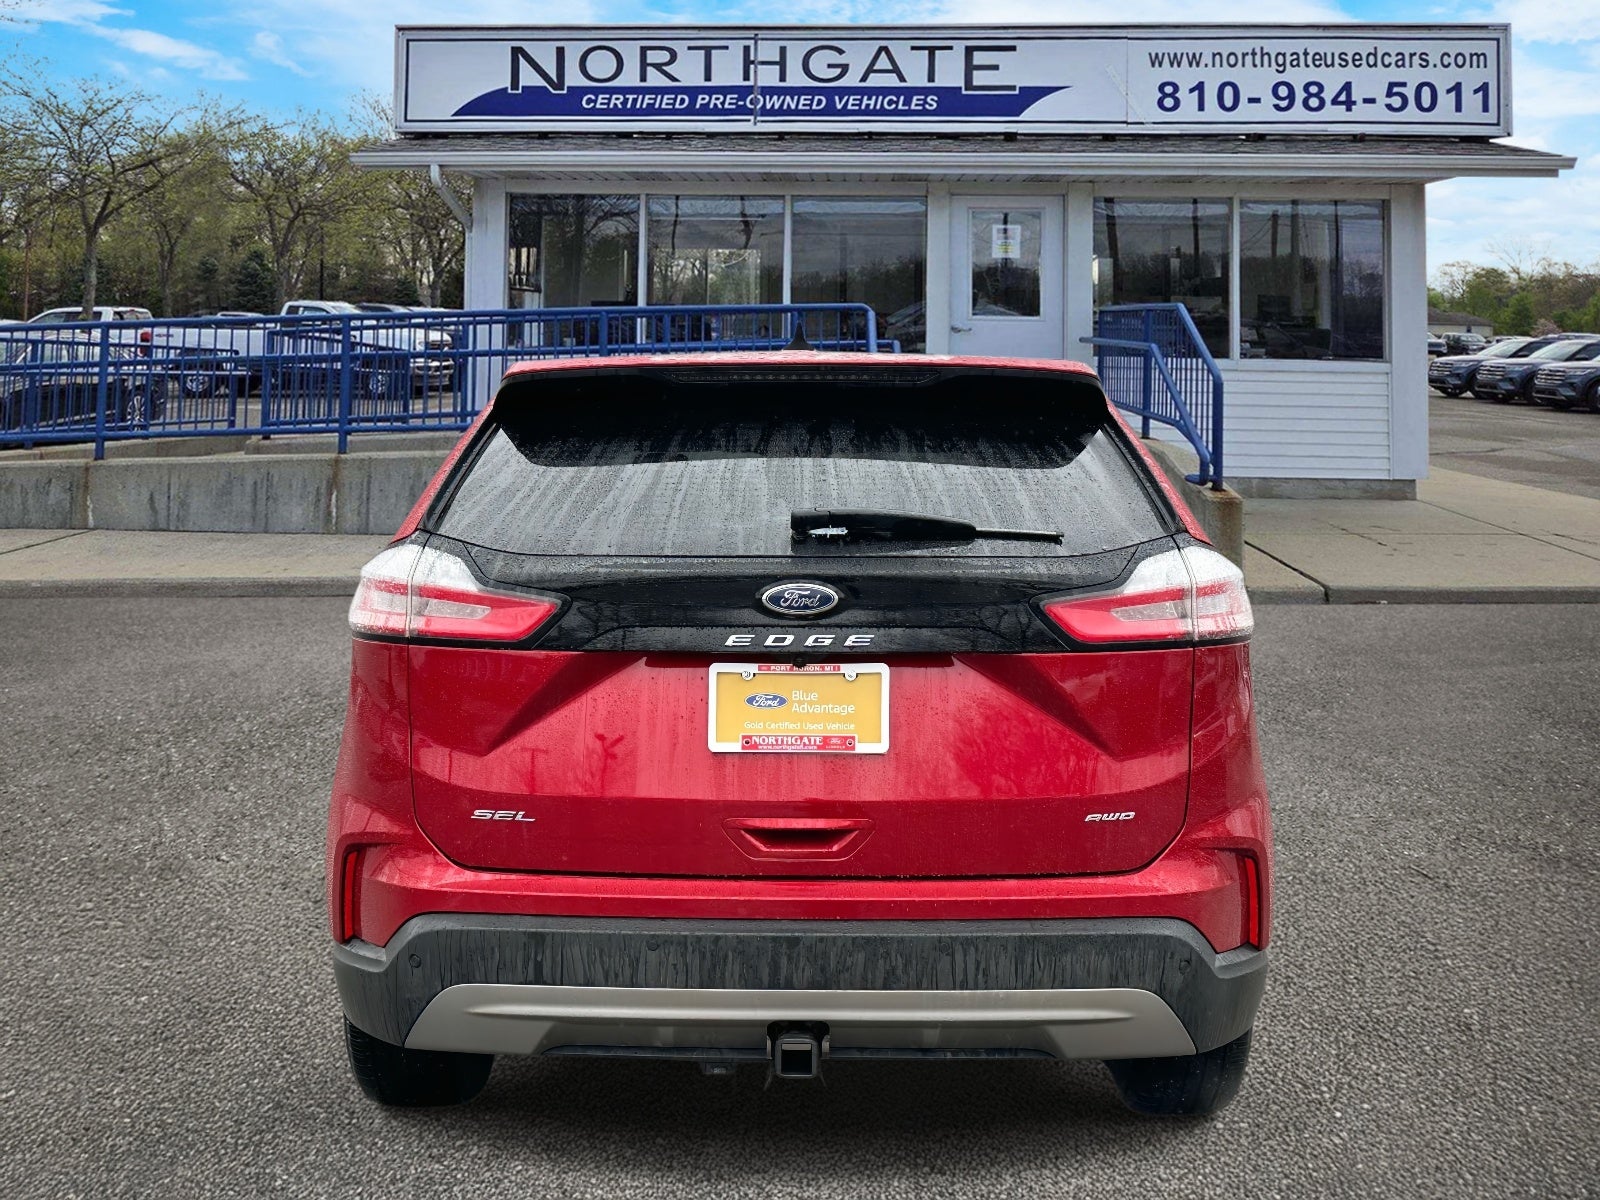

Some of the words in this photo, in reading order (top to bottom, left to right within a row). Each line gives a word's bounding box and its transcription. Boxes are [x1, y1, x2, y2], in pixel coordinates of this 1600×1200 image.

[1148, 46, 1488, 74] www.northgateusedcars.com
[509, 45, 1017, 93] NORTHGATE
[581, 94, 689, 109] CERTIFIED
[695, 94, 827, 110] PRE-OWNED
[835, 95, 938, 110] VEHICLES
[1156, 80, 1491, 114] 810-984-5011
[780, 590, 820, 607] Ford
[725, 634, 875, 647] EDGE
[752, 695, 780, 707] Ford
[792, 690, 818, 701] Blue
[792, 703, 855, 715] Advantage
[744, 722, 763, 730] Gold
[766, 722, 800, 730] Certified
[803, 722, 823, 730] Used
[826, 722, 855, 731] Vehicle
[752, 736, 823, 745] NORTHGATE
[471, 810, 536, 821] SEL
[1085, 812, 1136, 821] AWD
